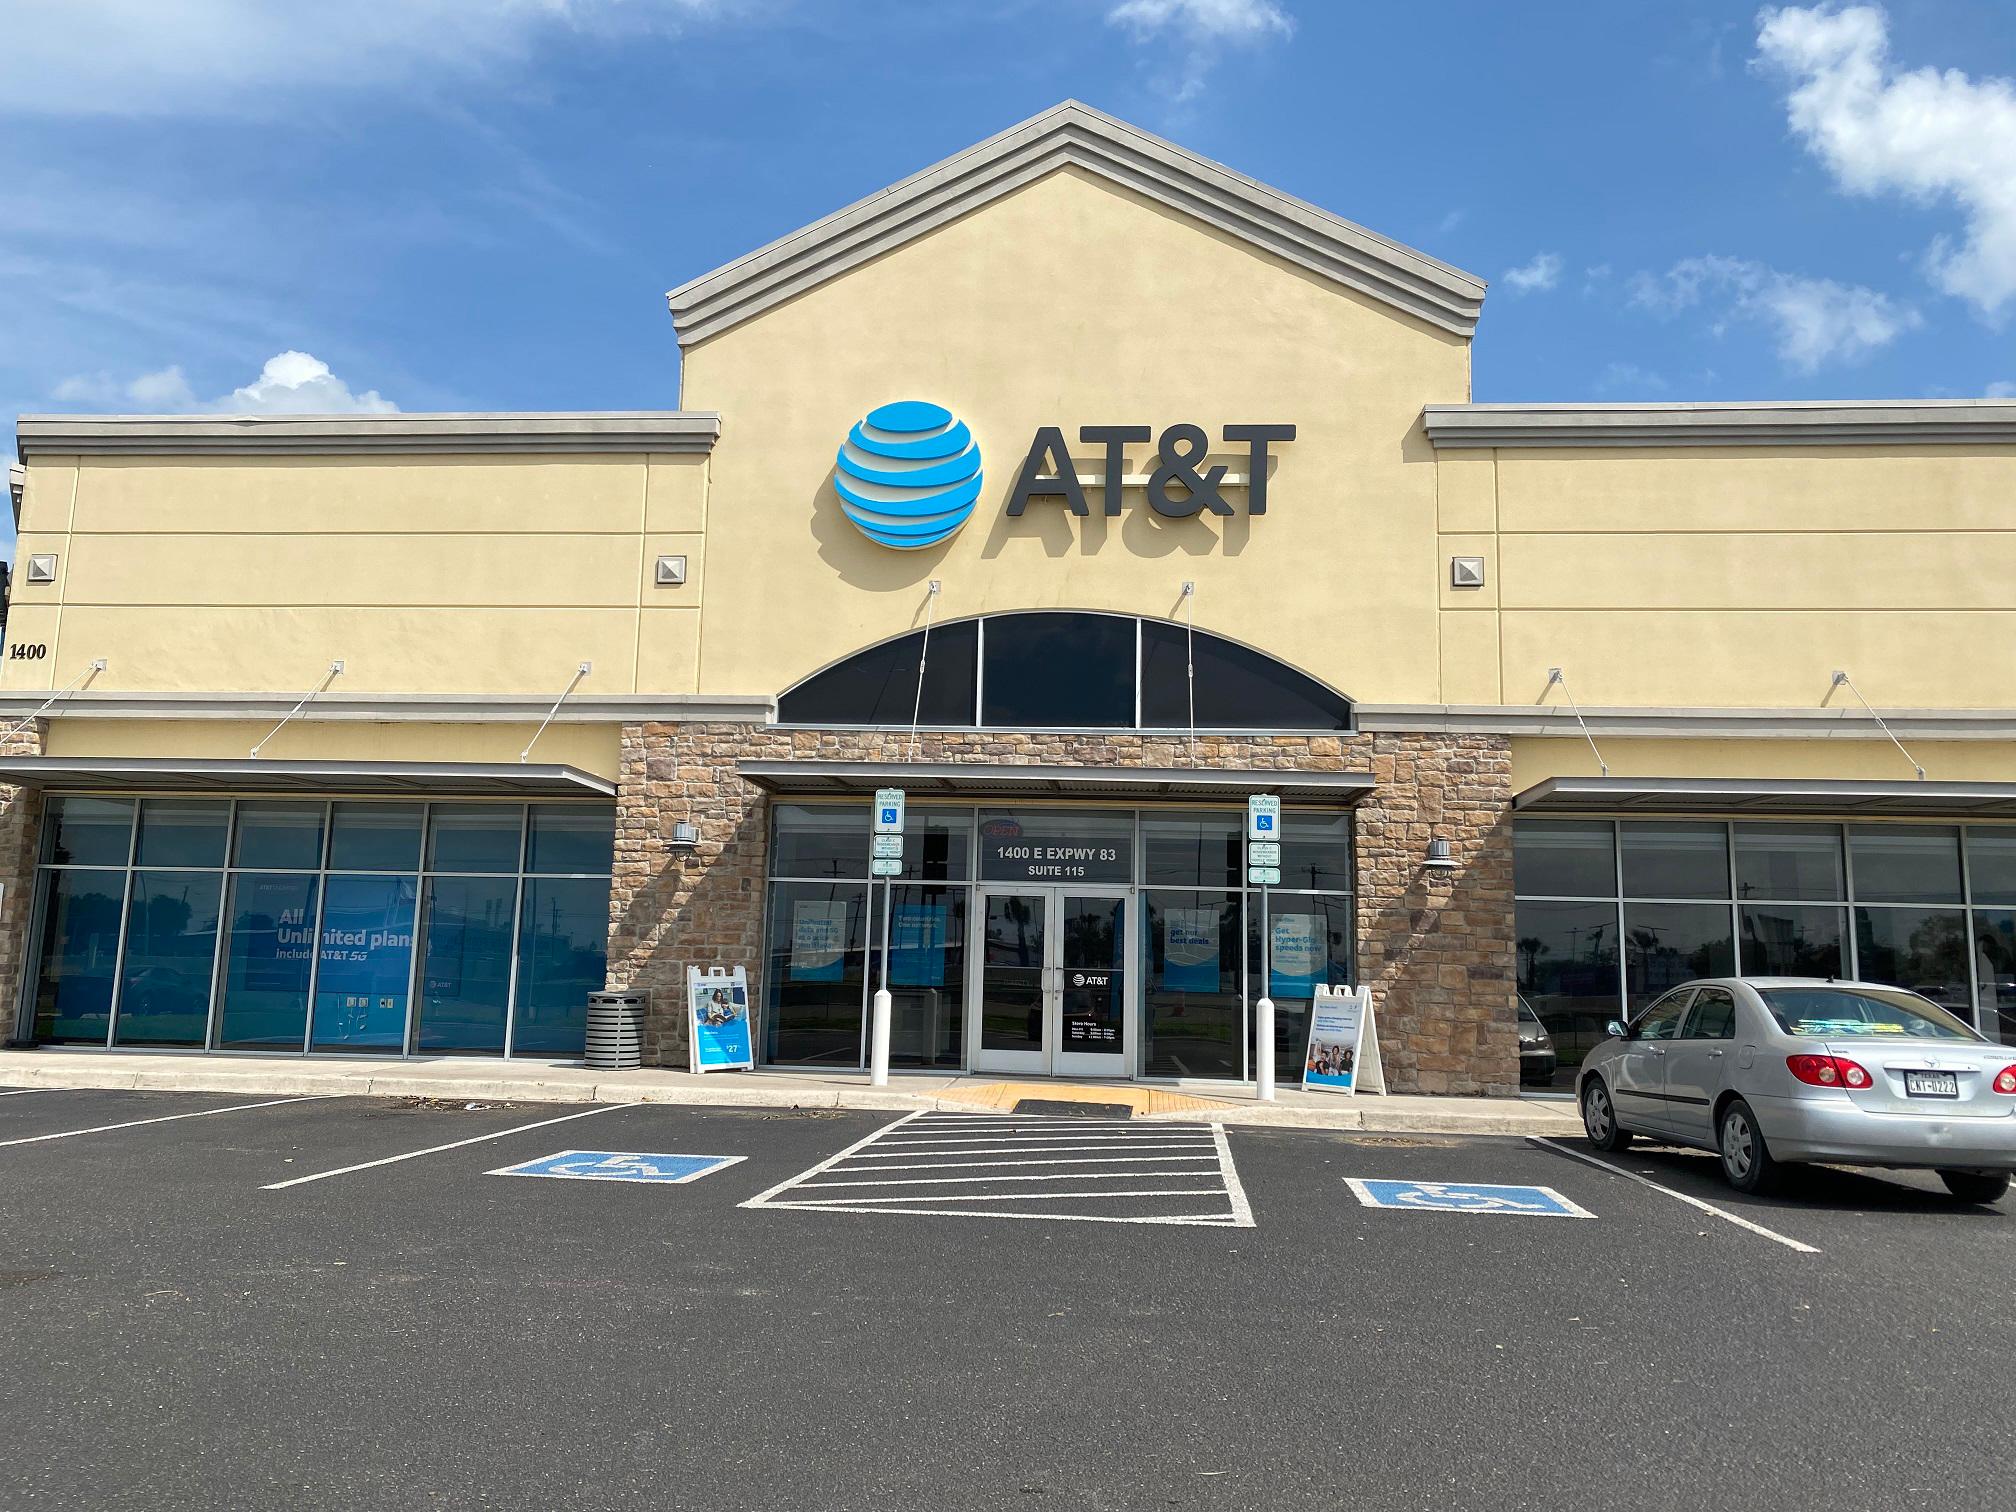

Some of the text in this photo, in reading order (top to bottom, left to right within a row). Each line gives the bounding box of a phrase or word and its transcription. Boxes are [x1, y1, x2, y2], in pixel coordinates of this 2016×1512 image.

[1006, 423, 1296, 518] AT&T
[9, 643, 47, 660] 1400
[997, 846, 1116, 861] 1400 E EXPWY 83
[1028, 865, 1085, 876] SUITE 115
[279, 908, 304, 925] All
[1170, 936, 1209, 945] best deals
[1275, 944, 1303, 952] speeds
[320, 950, 349, 960] AT&T
[349, 951, 368, 961] 5G
[1086, 976, 1109, 986] AT&T
